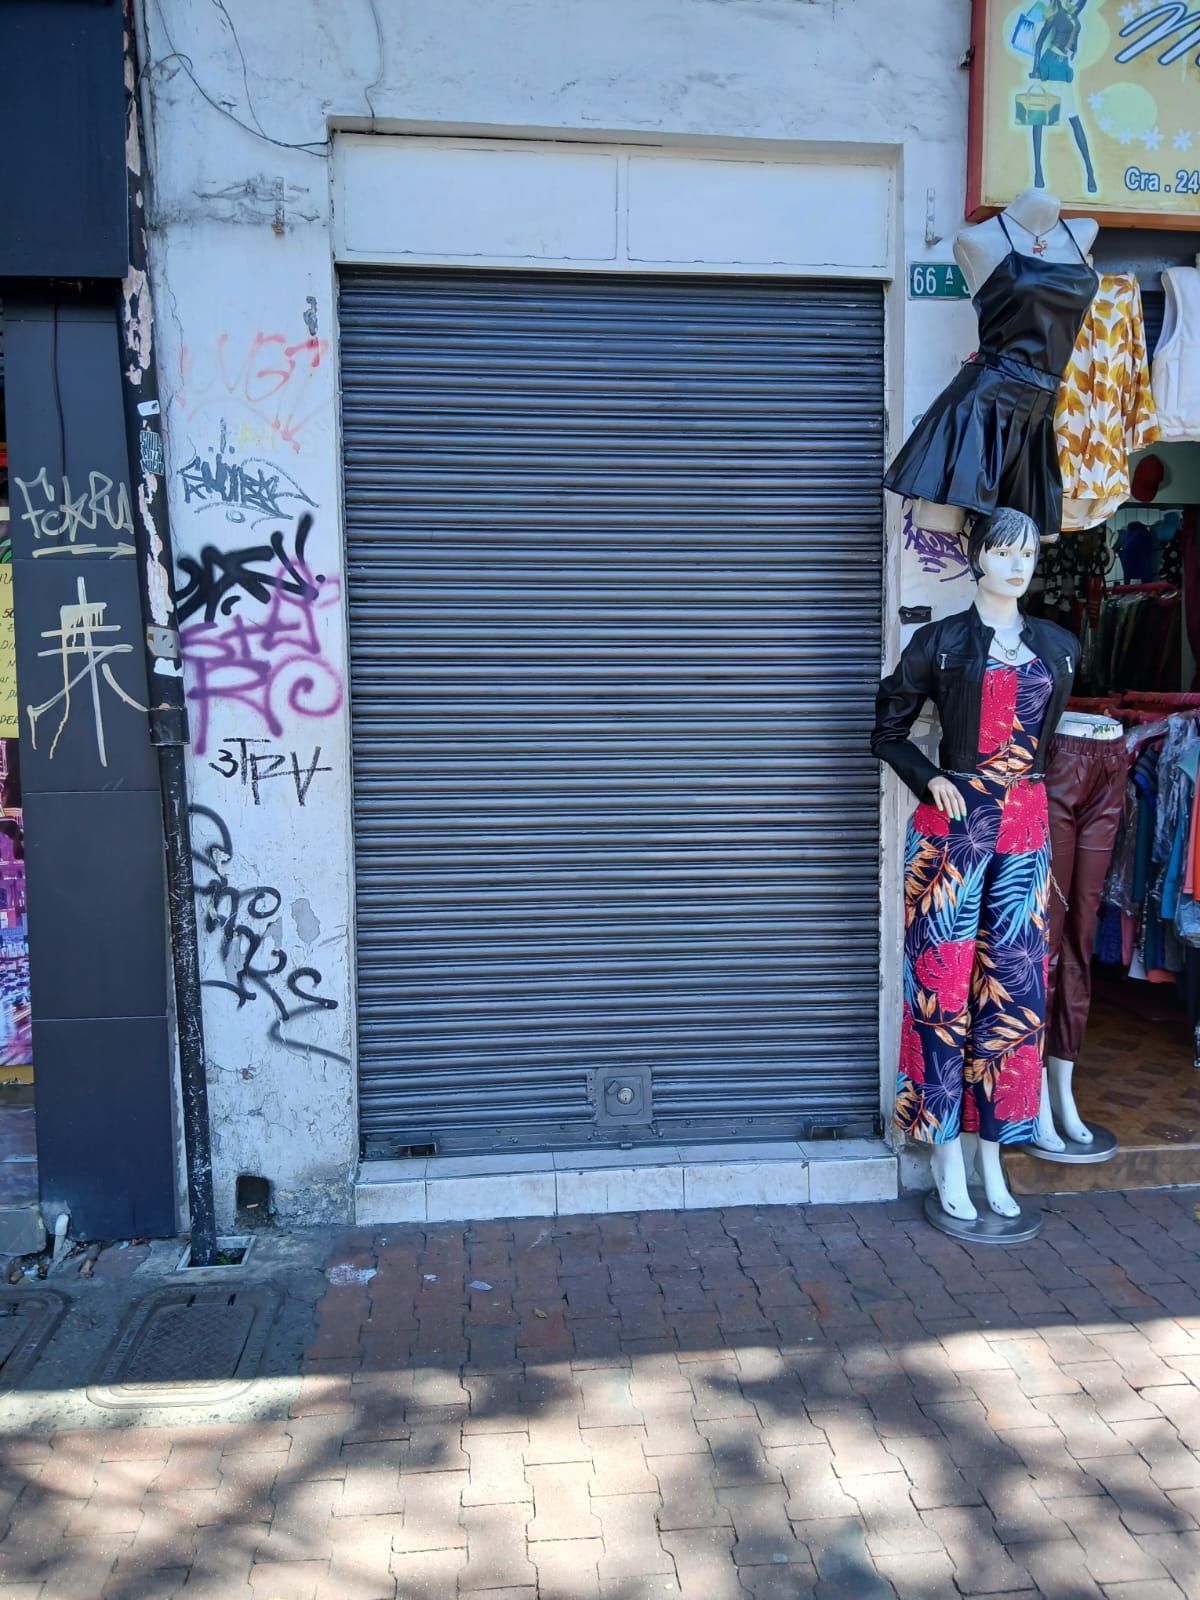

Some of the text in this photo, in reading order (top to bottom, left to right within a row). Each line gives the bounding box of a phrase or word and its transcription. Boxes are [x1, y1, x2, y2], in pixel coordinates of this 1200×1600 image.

[1125, 166, 1160, 191] Cra
[913, 266, 937, 294] 66
[945, 266, 954, 285] A
